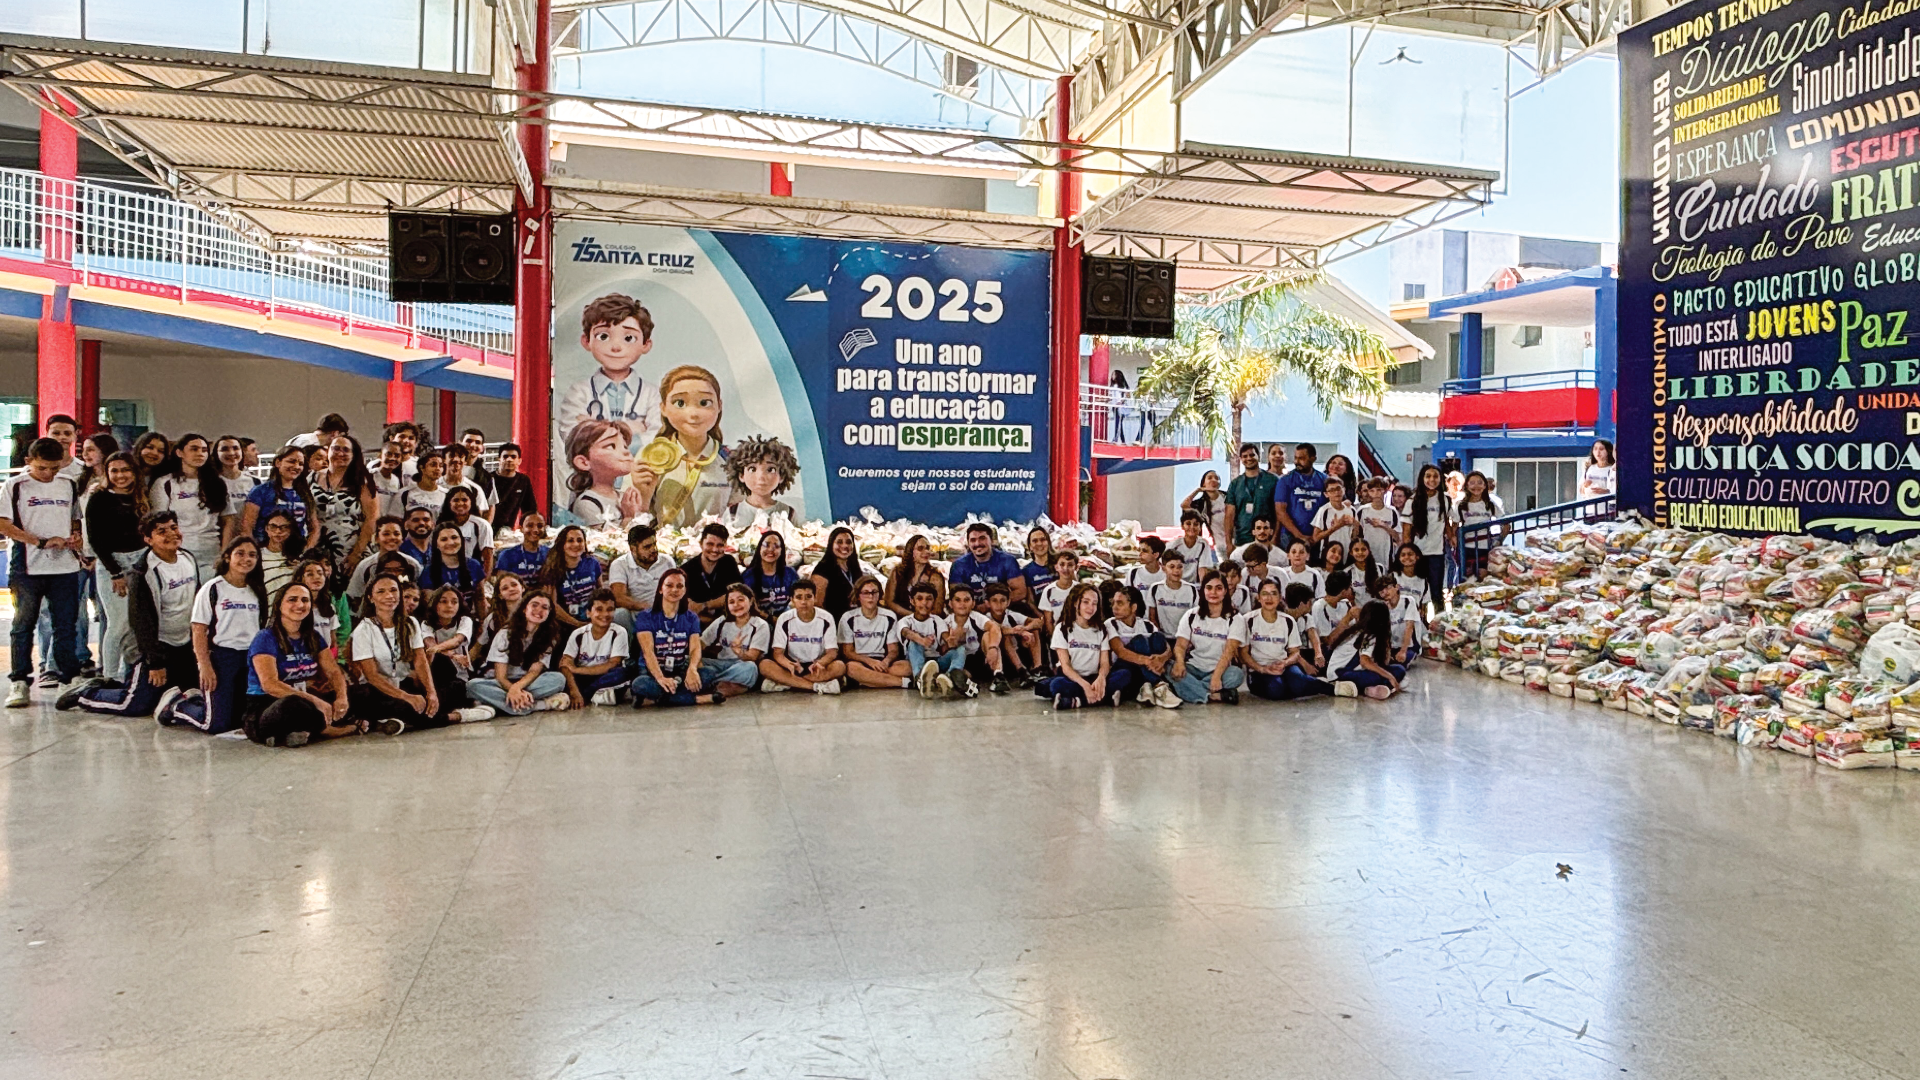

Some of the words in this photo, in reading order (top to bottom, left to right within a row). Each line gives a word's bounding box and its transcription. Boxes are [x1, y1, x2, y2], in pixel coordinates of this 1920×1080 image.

[1652, 12, 1713, 58] TEMPOS
[1674, 12, 1834, 98] Diálogo
[1792, 27, 1920, 115] Sinodalidade
[1653, 70, 1670, 136] BEM
[1674, 74, 1766, 121] SOLIDARIEDADE
[1674, 94, 1781, 145] INTERGERACIONAL
[1786, 89, 1920, 149] COMUNID
[1675, 126, 1778, 182] ESPERANÇA
[1830, 126, 1920, 174] ESCUT
[1652, 136, 1670, 245] COMUM
[1674, 152, 1820, 242] Cuidado
[1831, 161, 1920, 224] FRAT
[648, 252, 694, 268] CRUZ
[1652, 243, 1745, 282] Teologia
[1751, 230, 1779, 261] do
[1782, 212, 1854, 257] Povo
[861, 274, 1004, 324] 2025
[1653, 293, 1667, 313] O
[1673, 285, 1726, 316] PACTO
[1734, 265, 1844, 307] EDUCATIVO
[1854, 252, 1920, 290] GLOB
[1667, 323, 1702, 347] TUDO
[1706, 314, 1739, 343] ESTÁ
[1746, 300, 1836, 341] JOVENS
[1838, 301, 1908, 362] Paz
[895, 338, 934, 365] Um
[938, 344, 982, 366] ano
[1653, 318, 1667, 407] MUNDO
[1699, 341, 1793, 371] INTERLIGADO
[837, 368, 892, 392] para
[898, 368, 1037, 395] transformar
[1667, 359, 1920, 400] LIBERDADE
[870, 396, 885, 418] a
[890, 394, 1005, 424] educação
[1672, 395, 1859, 448] Responsabilidade
[843, 424, 896, 446] com
[901, 425, 1029, 453] esperança.
[1653, 412, 1667, 474] PODE
[1669, 444, 1790, 477] JUSTIÇA
[838, 466, 900, 478] Queremos
[903, 468, 926, 480] que
[928, 468, 971, 478] nossos
[973, 467, 1036, 479] estudantes
[901, 481, 936, 492] sejam
[938, 481, 947, 491] o
[949, 480, 968, 491] sol
[970, 480, 986, 491] do
[987, 481, 1035, 492] amanhã.
[1668, 477, 1740, 500] CULTURA
[1746, 478, 1774, 501] DO
[1779, 479, 1890, 505] ENCONTRO
[1670, 499, 1717, 531] RELAÇÃO
[1719, 504, 1802, 533] EDUCACIONAL
